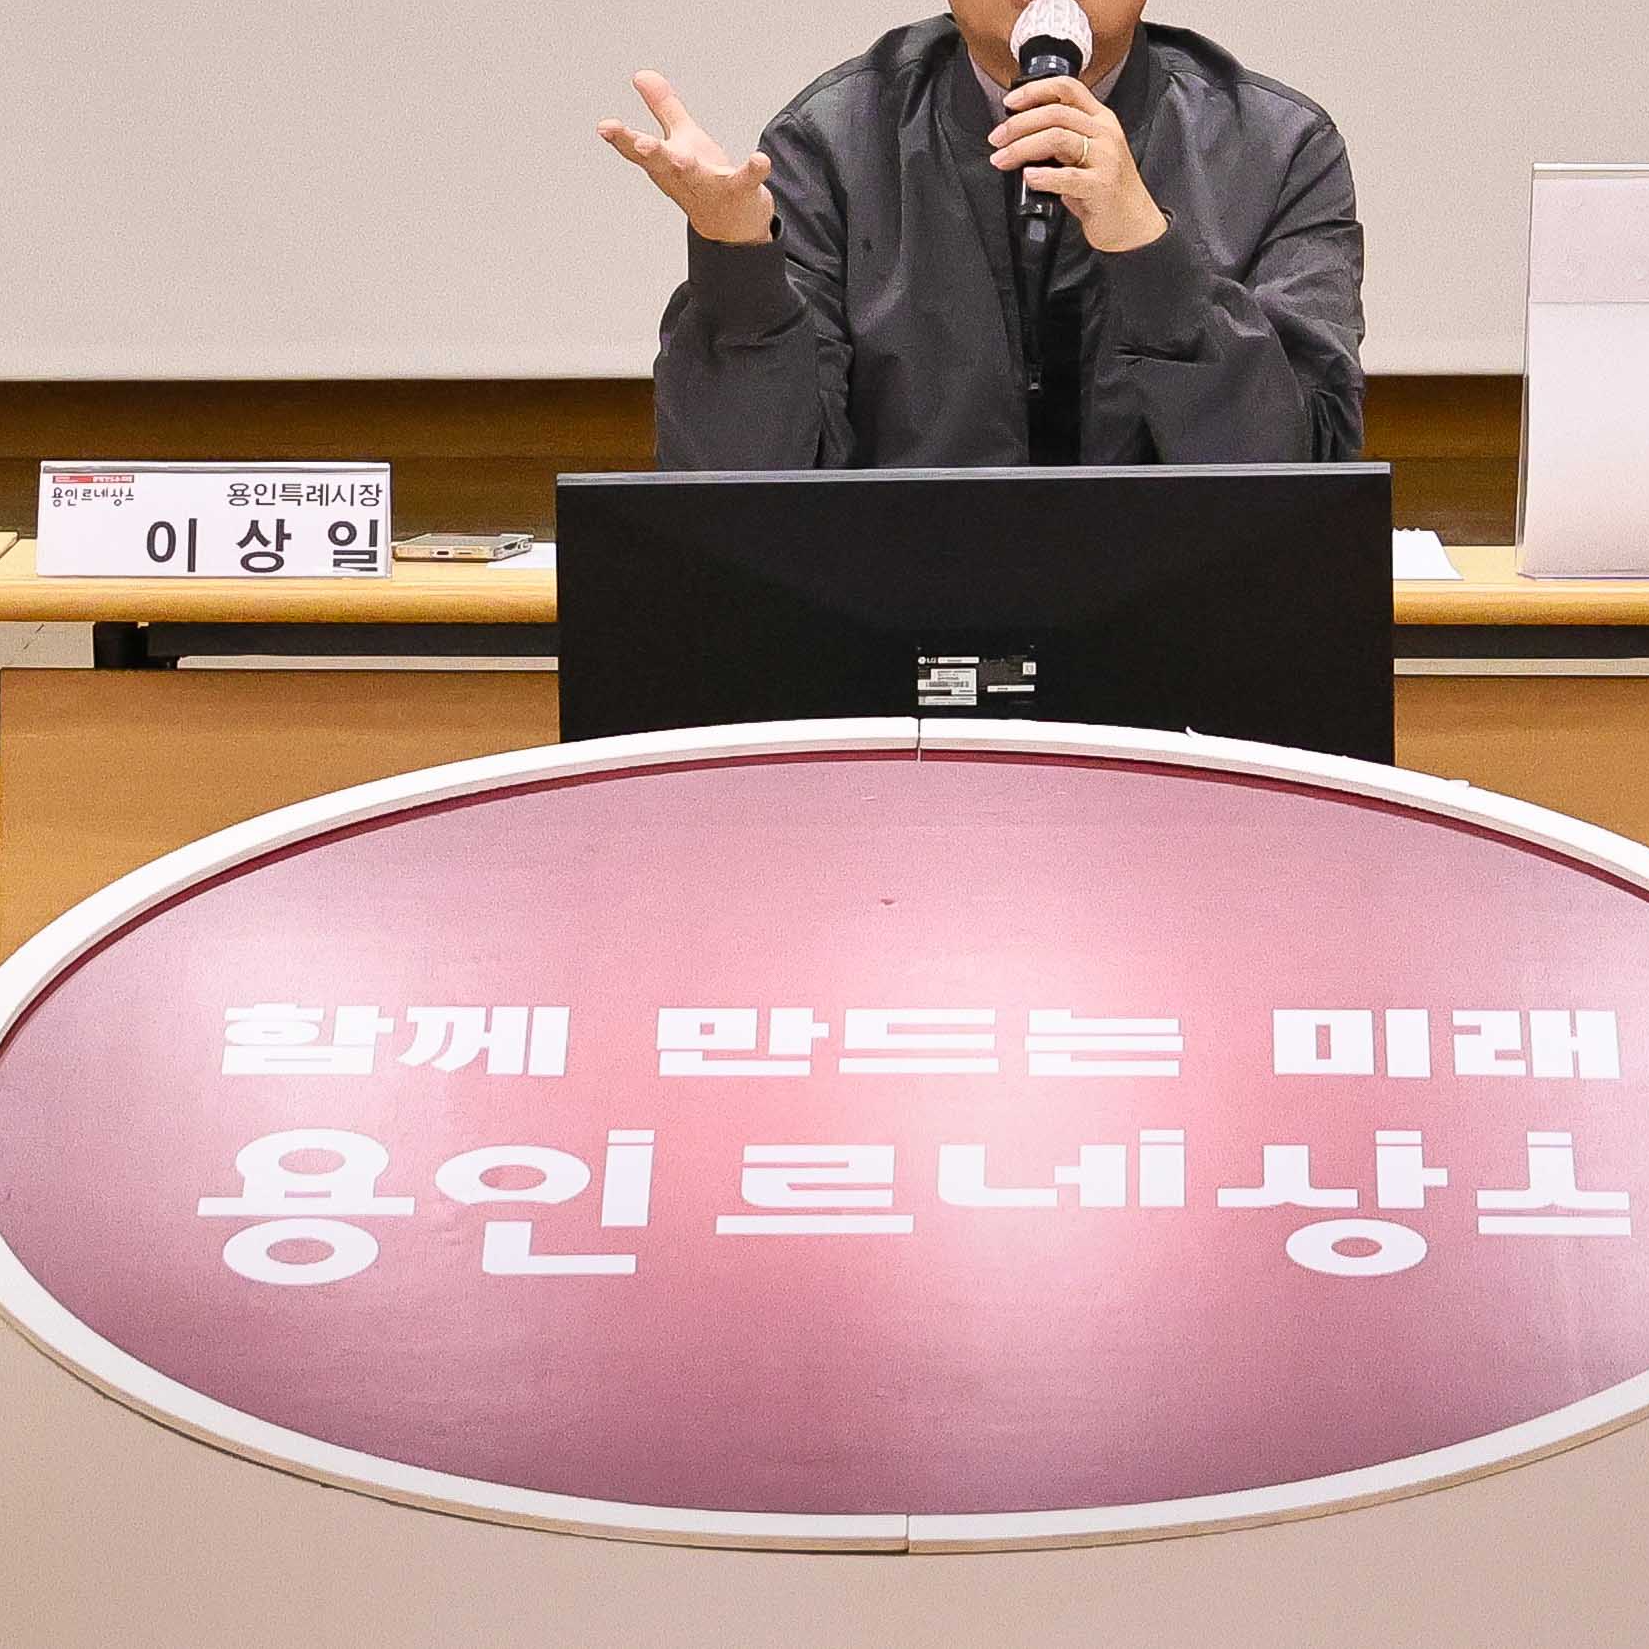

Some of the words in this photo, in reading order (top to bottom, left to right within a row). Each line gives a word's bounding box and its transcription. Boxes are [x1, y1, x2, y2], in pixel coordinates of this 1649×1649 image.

[226, 482, 383, 507] 용인특례시장
[222, 1003, 571, 1076] 함께
[657, 1007, 1184, 1077] 만드는
[1272, 1008, 1622, 1080] 미래
